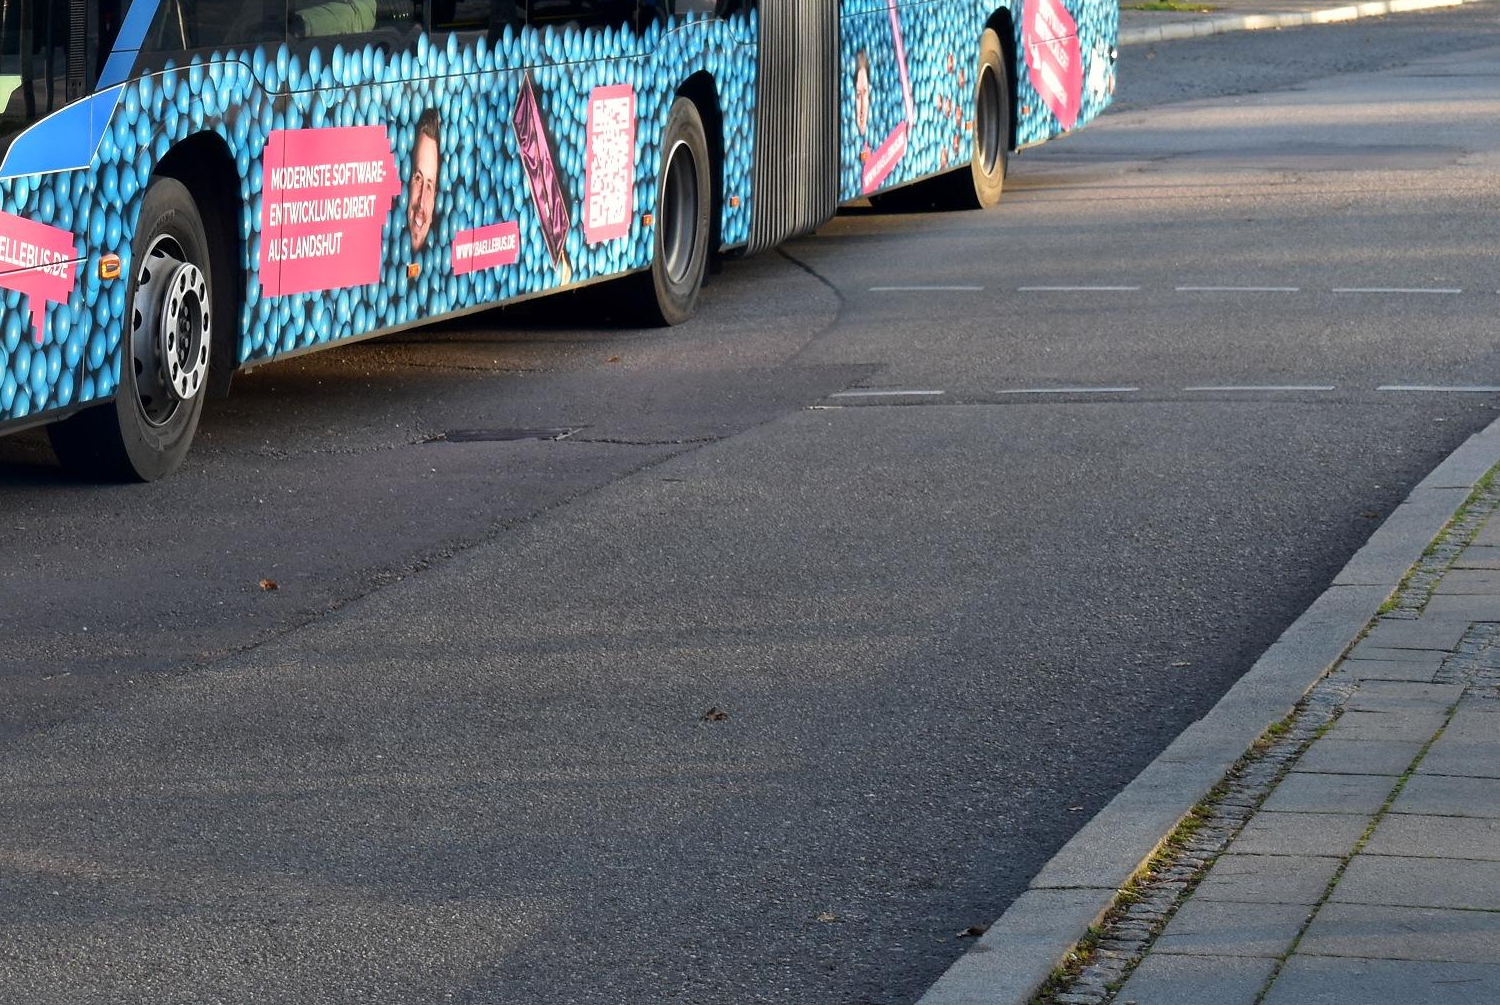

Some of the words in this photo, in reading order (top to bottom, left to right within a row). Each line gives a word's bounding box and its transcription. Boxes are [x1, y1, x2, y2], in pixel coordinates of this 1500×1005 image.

[270, 163, 332, 191] MODERNSTE
[332, 160, 387, 187] SOFTWARE-
[269, 197, 342, 227] ENTWICKLUNG
[342, 194, 377, 220] DIREKT
[267, 237, 288, 262] AUS
[289, 231, 343, 260] LANDSHUT
